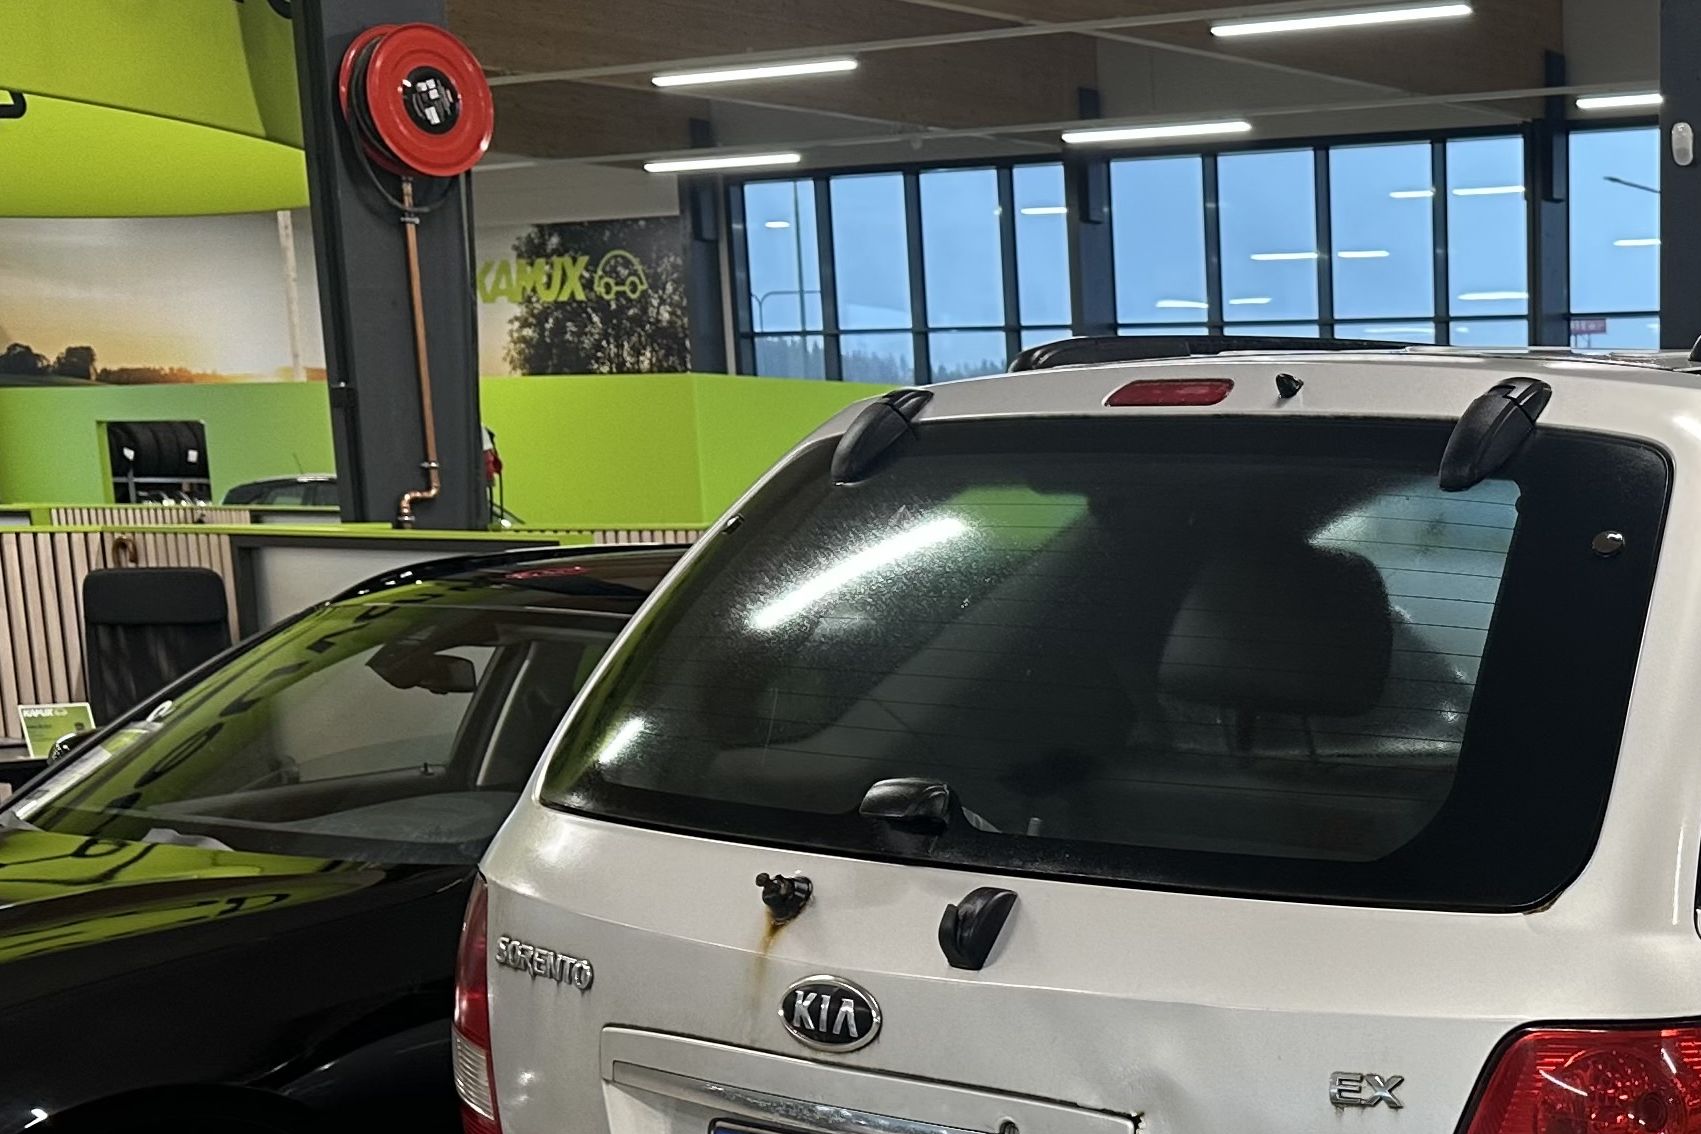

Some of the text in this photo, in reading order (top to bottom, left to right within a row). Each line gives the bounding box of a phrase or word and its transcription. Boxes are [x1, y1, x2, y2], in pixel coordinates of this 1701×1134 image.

[495, 936, 594, 991] SORENTO
[792, 990, 859, 1038] KIA
[1329, 1071, 1405, 1109] EX
